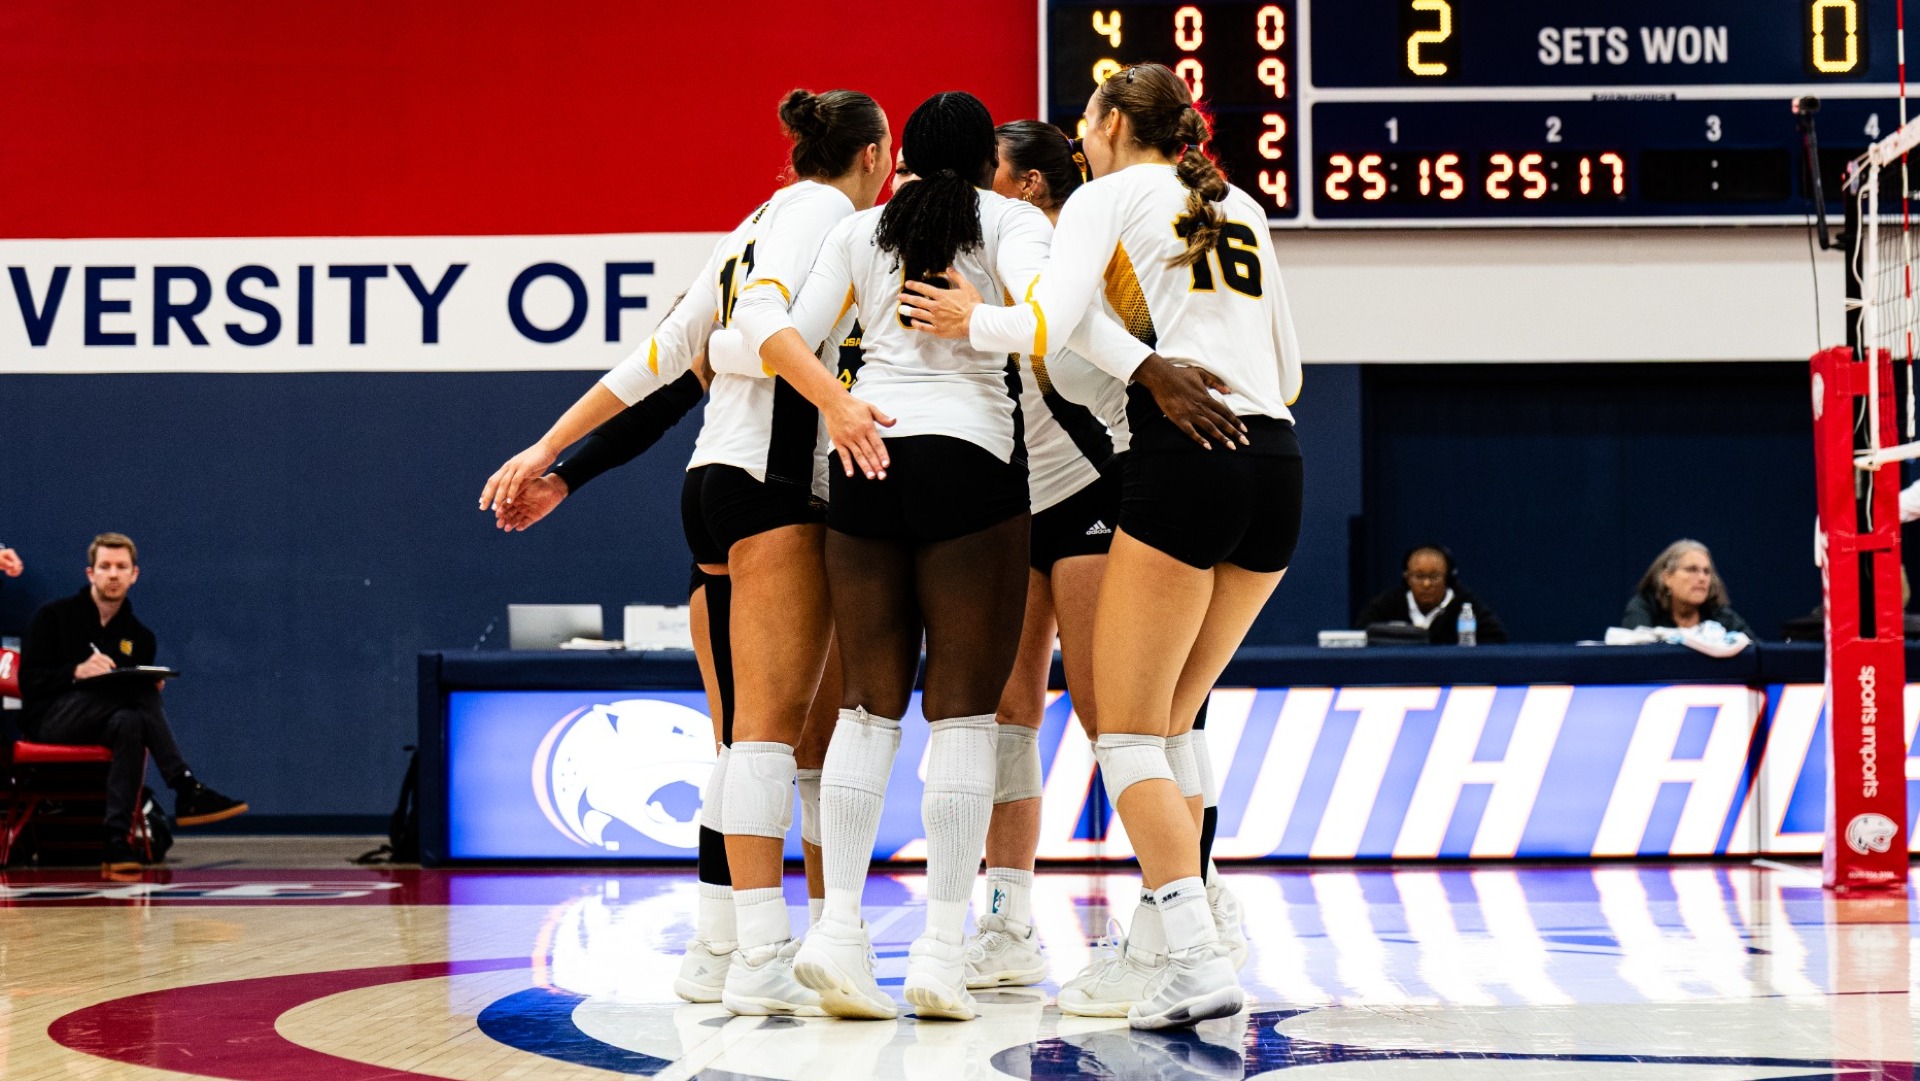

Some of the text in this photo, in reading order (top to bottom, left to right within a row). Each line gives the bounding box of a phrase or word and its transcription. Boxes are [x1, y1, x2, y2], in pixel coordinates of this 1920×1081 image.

[1092, 10, 1122, 48] 4
[1174, 6, 1203, 51] 0
[1257, 5, 1285, 51] 0
[1407, 0, 1452, 76] 2
[1538, 26, 1729, 66] SETS WON
[1811, 0, 1858, 73] 0
[1257, 57, 1286, 99] 9
[1258, 113, 1287, 160] 2
[1384, 116, 1399, 144] 1
[1545, 115, 1563, 143] 2
[1705, 115, 1722, 142] 3
[1863, 113, 1881, 140] 4
[1257, 169, 1288, 208] 4
[1170, 213, 1264, 300] 16
[7, 261, 655, 347] VERSITY OF
[1857, 665, 1880, 799] sports imports
